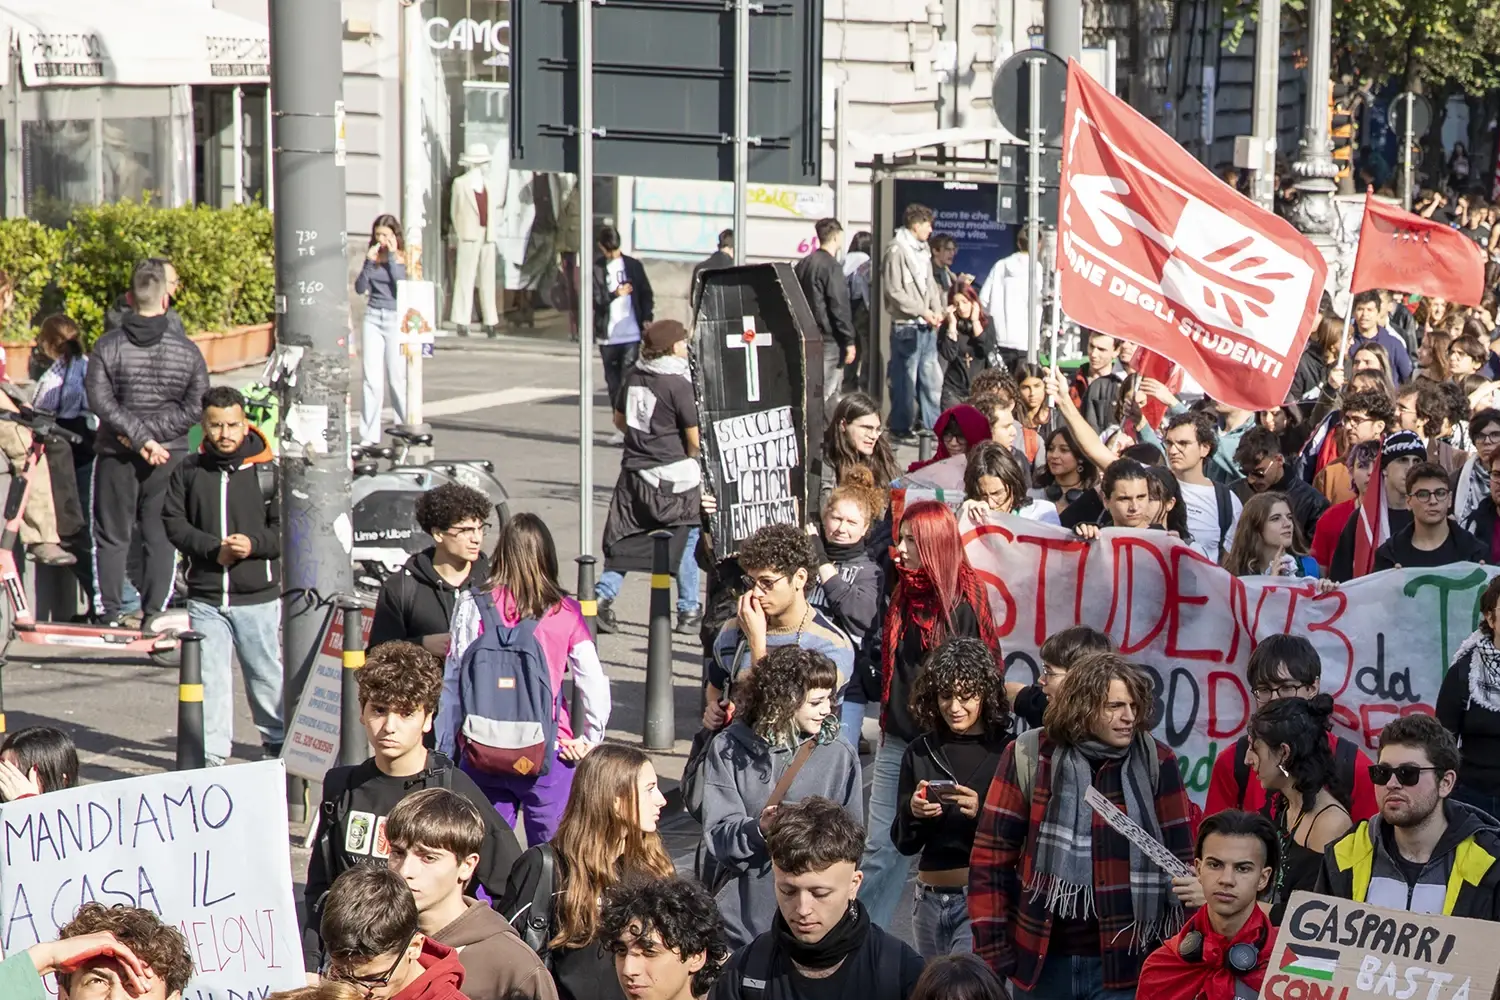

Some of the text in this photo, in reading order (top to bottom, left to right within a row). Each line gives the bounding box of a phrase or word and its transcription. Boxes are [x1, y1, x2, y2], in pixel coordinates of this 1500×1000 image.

[1108, 277, 1175, 324] DEGLI
[1177, 315, 1284, 379] STUDENTI
[354, 530, 379, 541] Lime
[386, 528, 411, 539] Uber
[1355, 632, 1422, 702] da
[4, 783, 234, 866] MANDIAMO
[5, 883, 41, 951] A
[191, 849, 236, 908] IL
[1288, 899, 1457, 965] GASPARRI
[176, 909, 282, 978] ELONI
